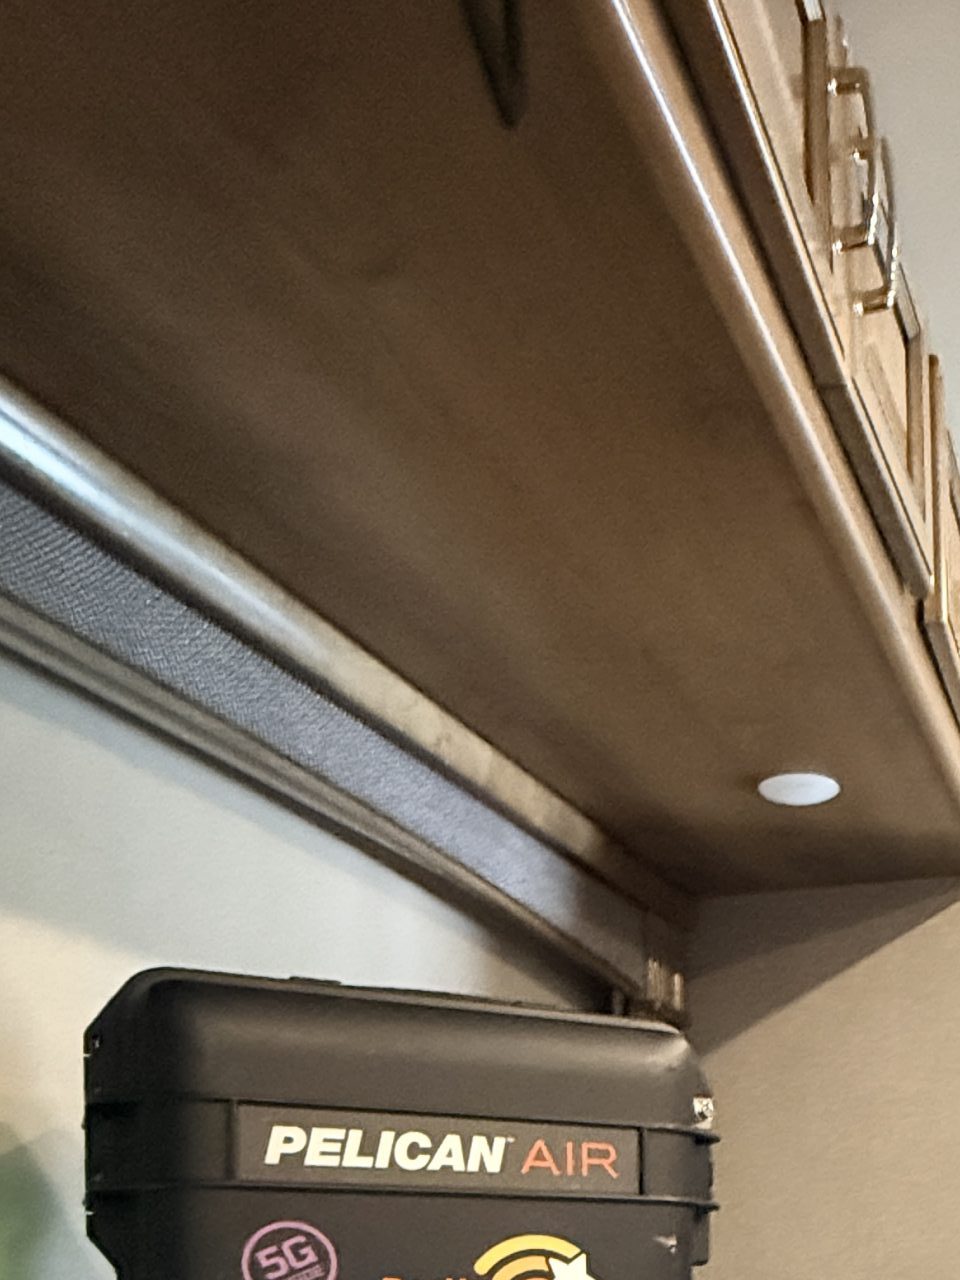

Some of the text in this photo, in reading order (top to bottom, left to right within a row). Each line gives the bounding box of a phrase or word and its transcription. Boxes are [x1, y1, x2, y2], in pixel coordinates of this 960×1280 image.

[264, 1125, 620, 1178] PELICAN AIR
[254, 1235, 319, 1279] 5G
